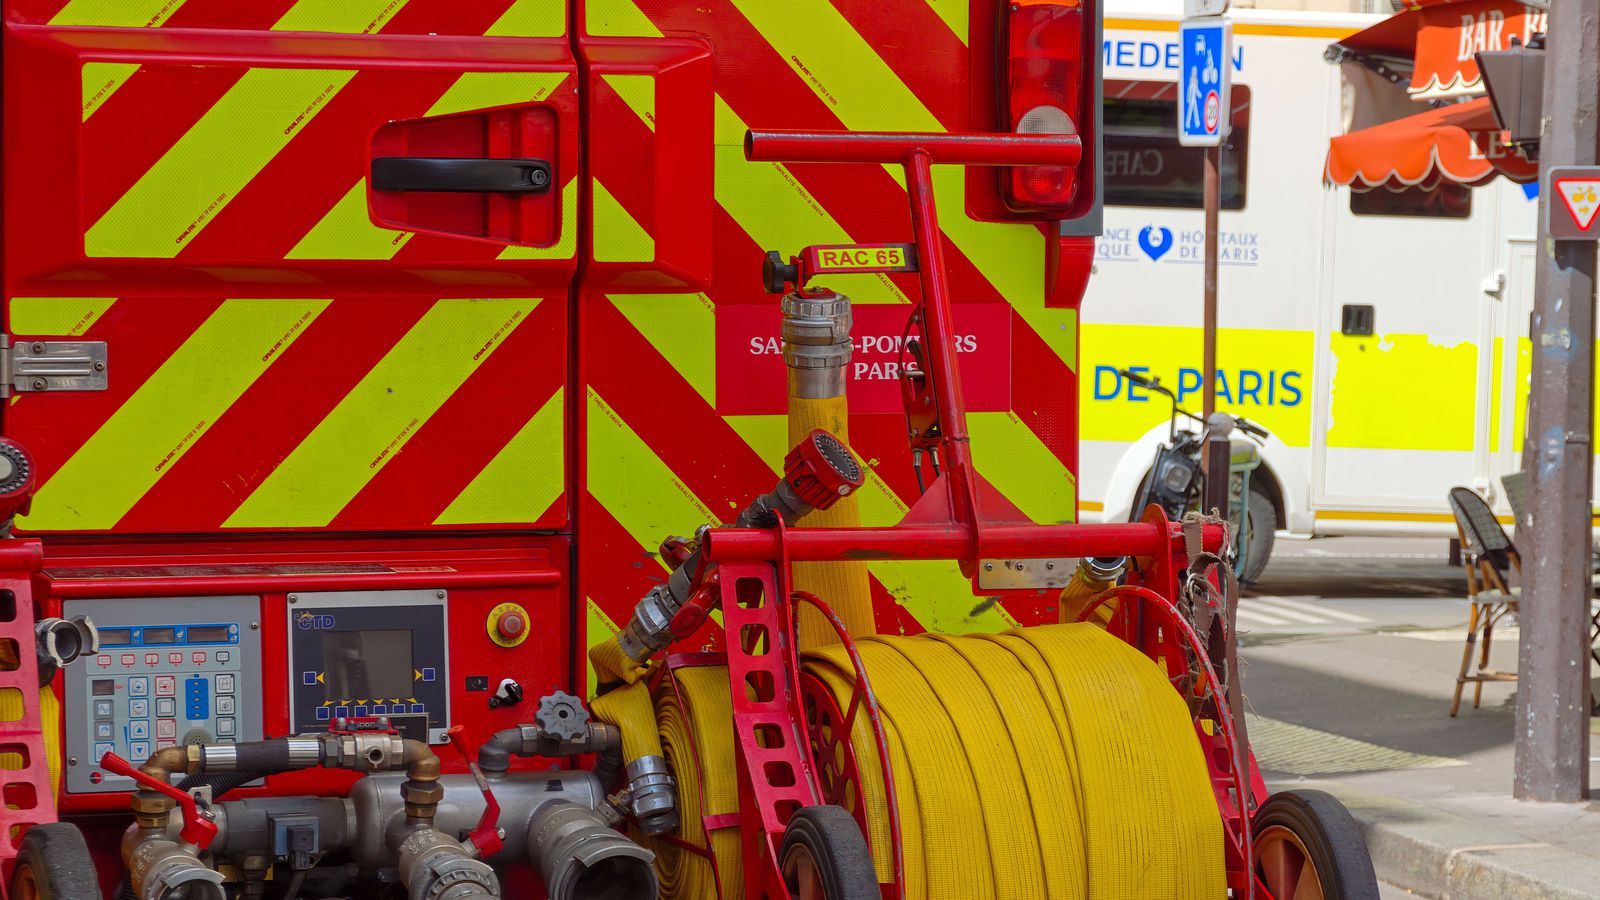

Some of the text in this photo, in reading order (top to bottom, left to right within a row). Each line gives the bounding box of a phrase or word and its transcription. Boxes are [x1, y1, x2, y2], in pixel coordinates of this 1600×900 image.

[1457, 9, 1504, 61] BAR
[1180, 230, 1258, 245] HÔTAUX
[823, 250, 900, 266] RAC 65
[1221, 248, 1259, 261] ARIS
[1094, 365, 1303, 407] DE PARIS
[297, 614, 335, 630] CTD
